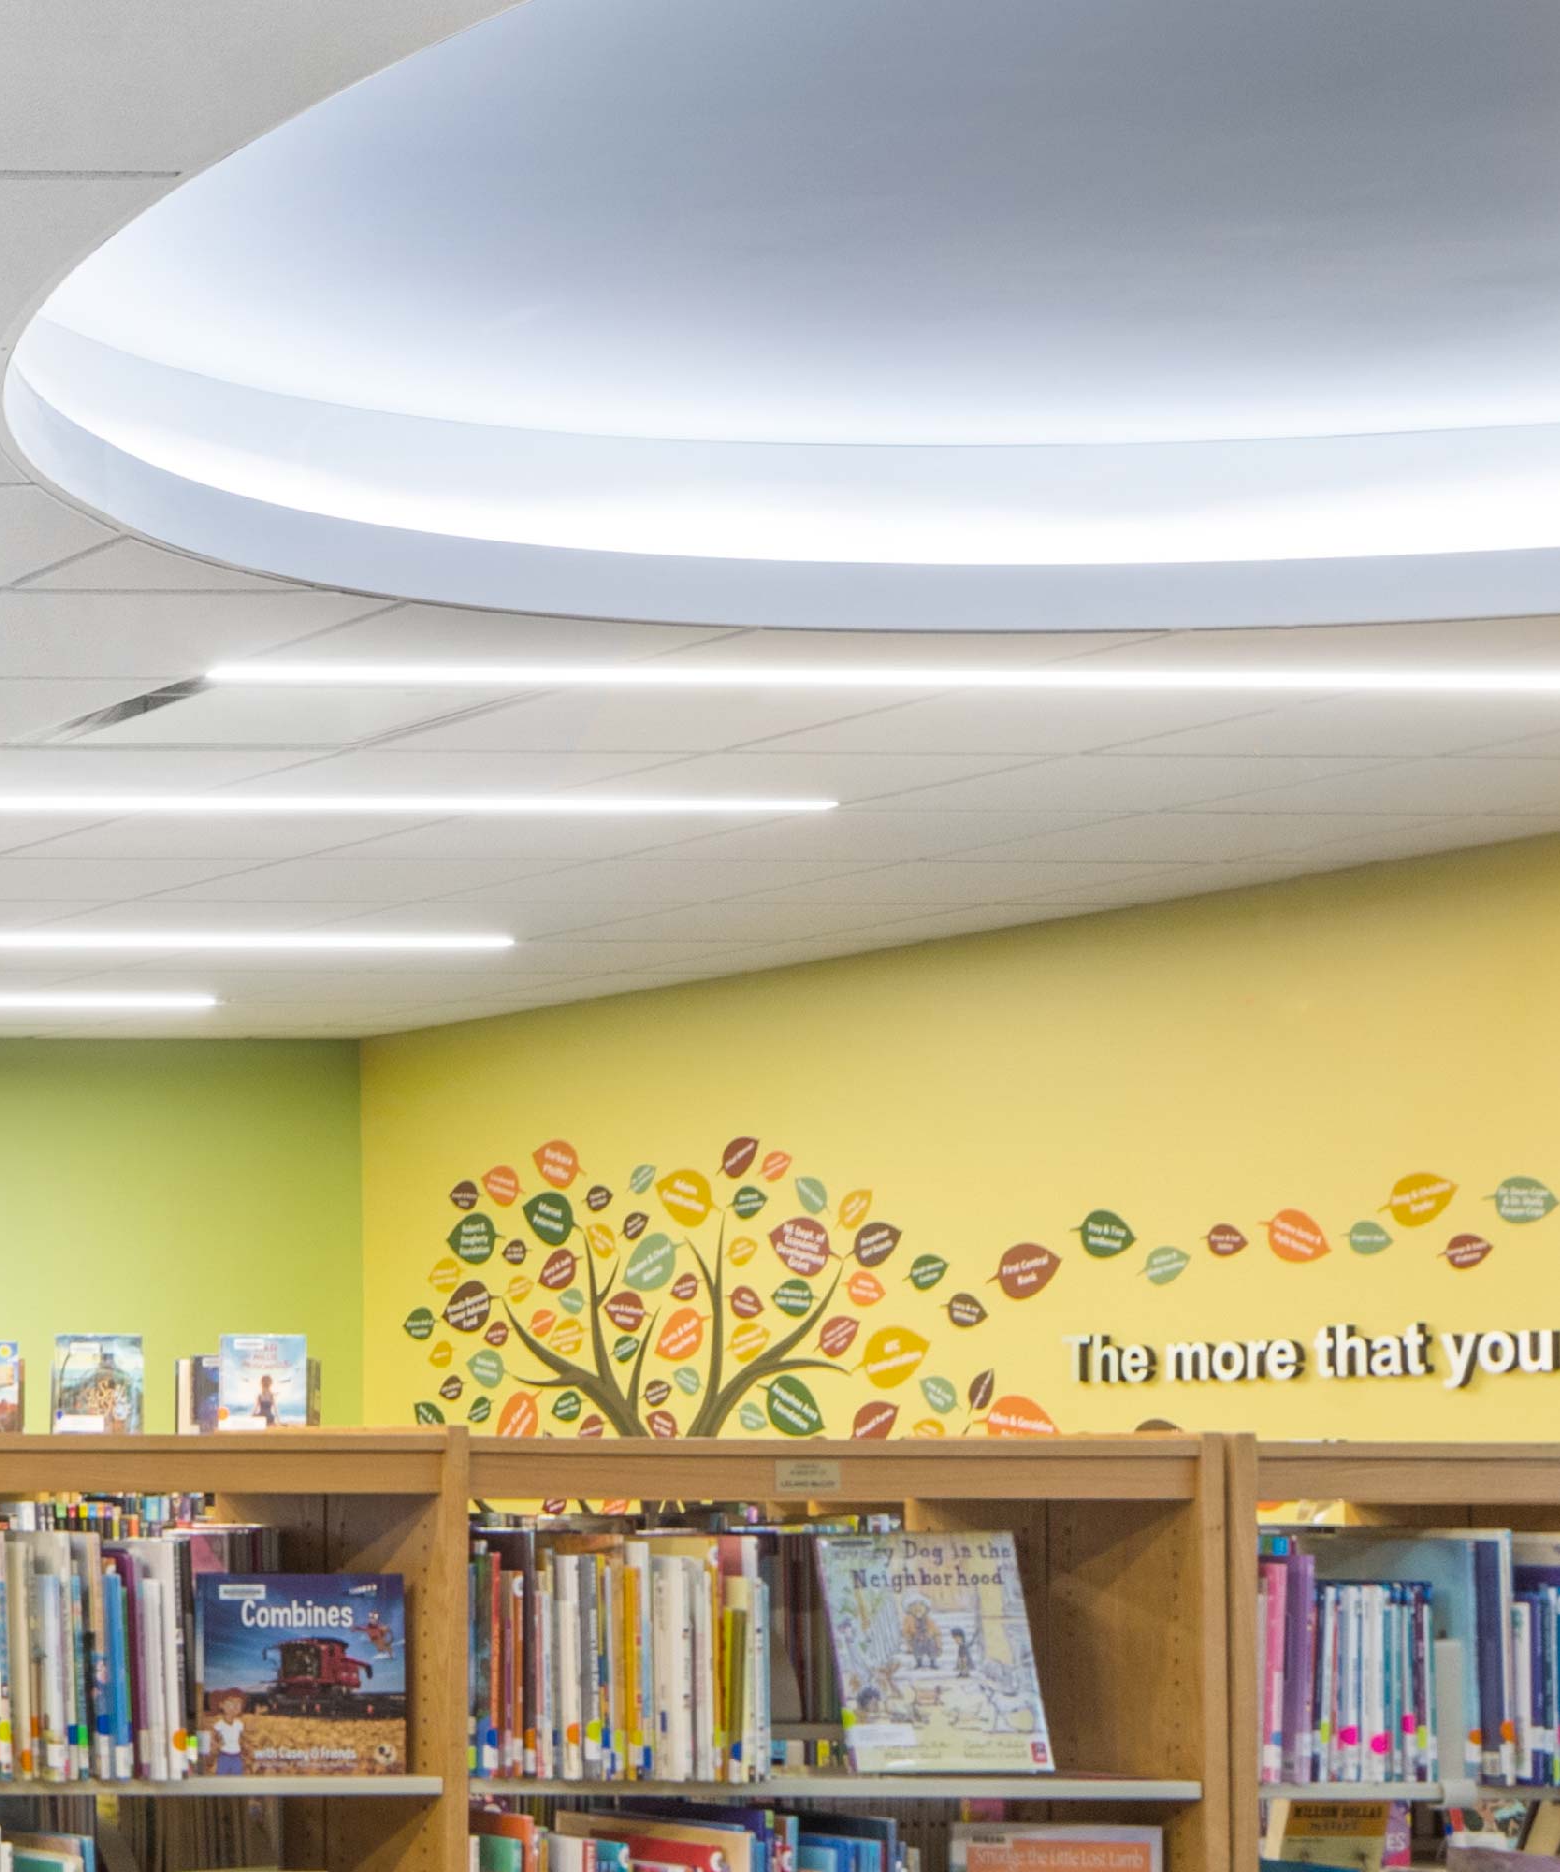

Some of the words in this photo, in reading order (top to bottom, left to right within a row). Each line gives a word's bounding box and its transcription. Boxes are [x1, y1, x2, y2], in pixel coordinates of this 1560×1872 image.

[776, 1242, 826, 1266] Development
[784, 1234, 820, 1251] Economic
[1001, 1263, 1020, 1277] First
[1020, 1253, 1049, 1272] Central
[1016, 1271, 1038, 1287] Bank
[1062, 1334, 1154, 1383] The
[1166, 1337, 1302, 1382] more
[1314, 1324, 1431, 1378] that
[1442, 1329, 1560, 1388] you
[902, 1540, 943, 1566] Dog
[952, 1542, 971, 1559] in
[979, 1542, 1011, 1559] the
[852, 1567, 1004, 1592] Neighborhood
[240, 1599, 354, 1628] Combines
[320, 1746, 357, 1760] Friends
[975, 1849, 1023, 1866] Smudge
[1029, 1851, 1047, 1865] the
[1049, 1850, 1080, 1866] Little
[1081, 1852, 1106, 1866] Lost
[1109, 1851, 1144, 1868] Lamb
